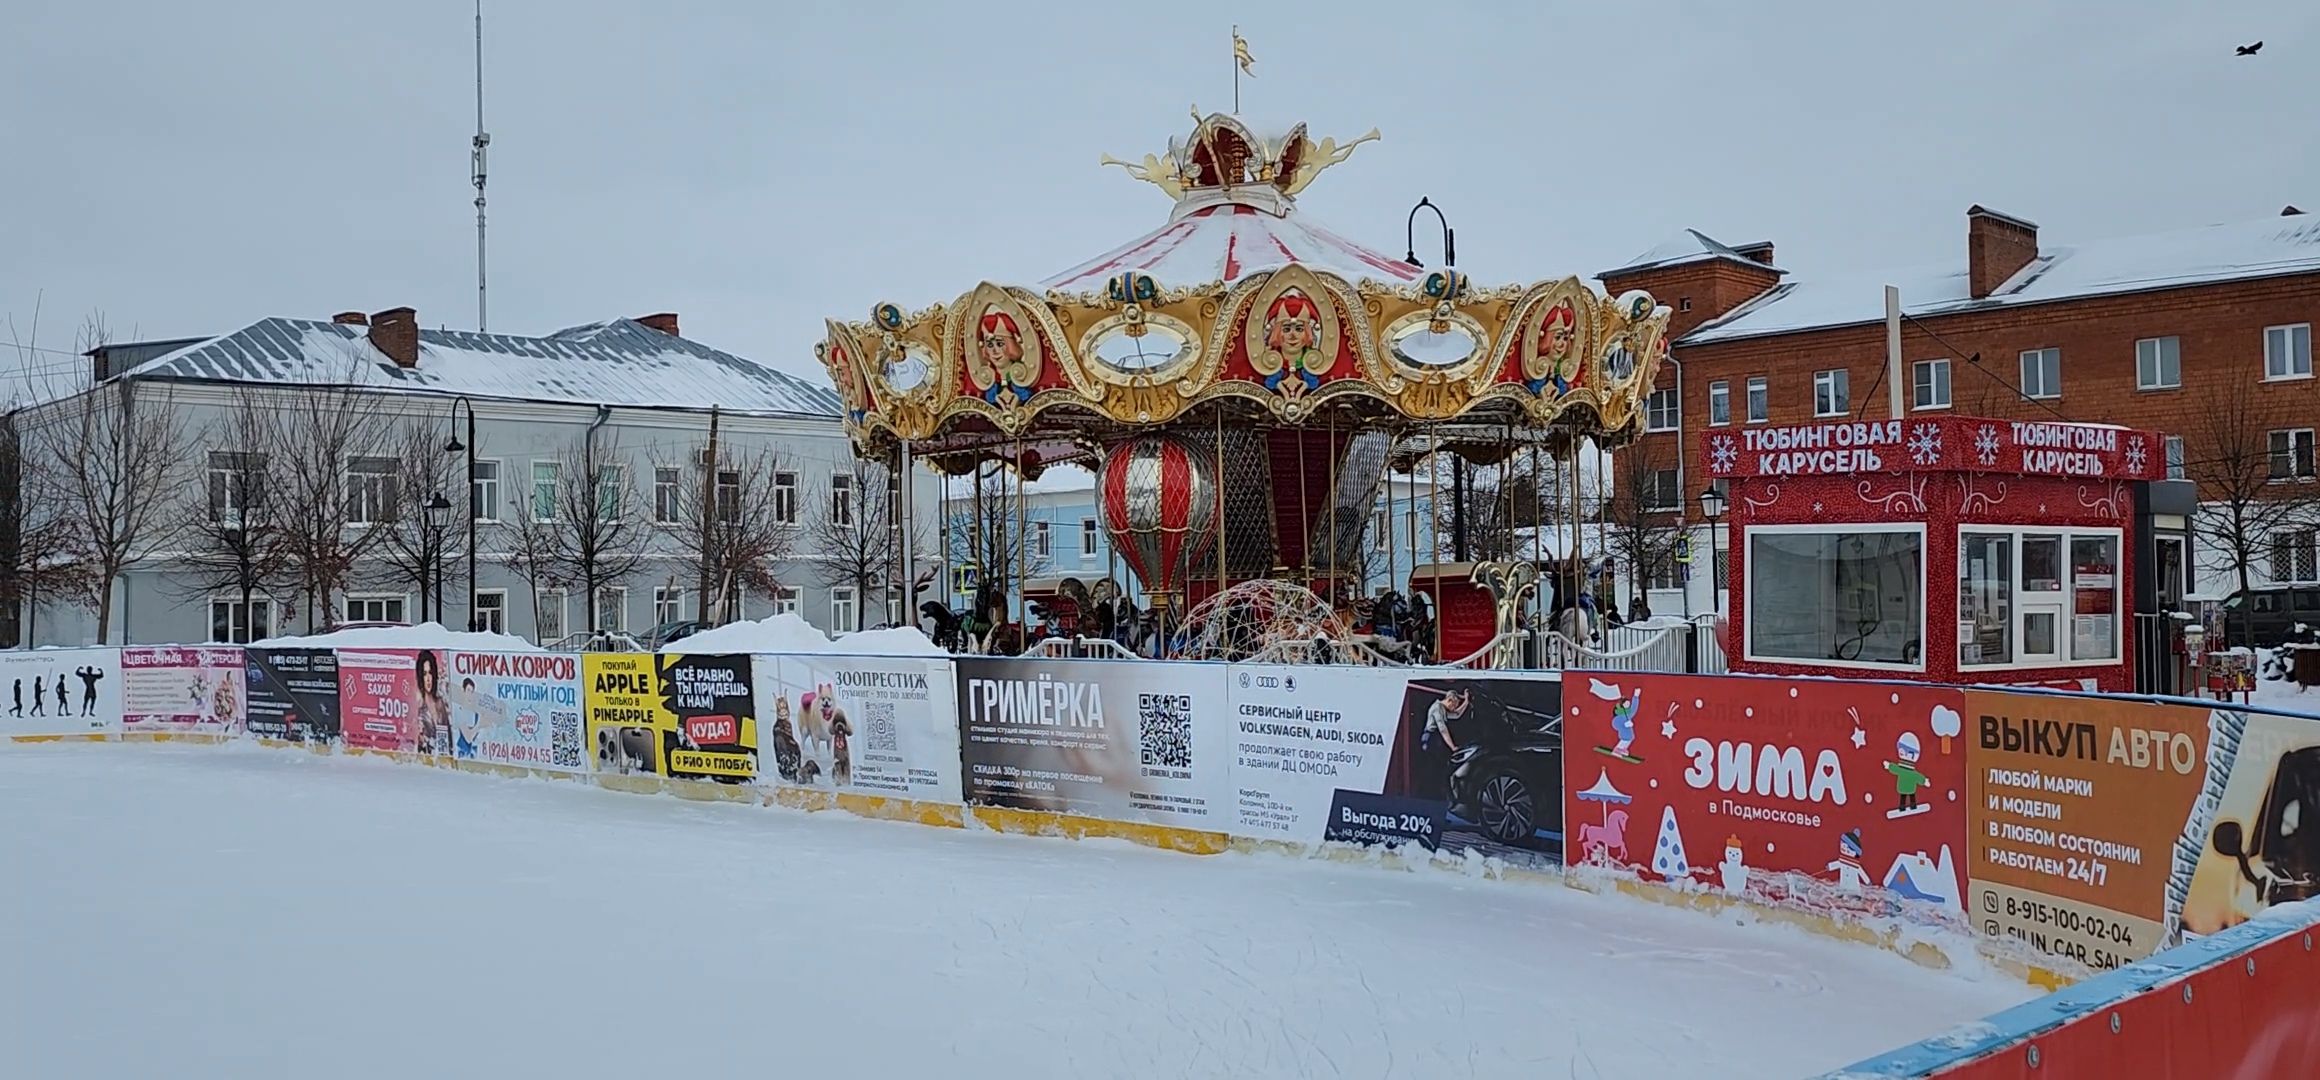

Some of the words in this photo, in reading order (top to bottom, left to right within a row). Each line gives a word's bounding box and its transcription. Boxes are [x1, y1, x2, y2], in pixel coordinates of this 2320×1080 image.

[1742, 420, 1902, 451] ТЮБИНГОВАЯ
[2011, 422, 2117, 452] ТЮБИНГОВАЯ
[1759, 447, 1882, 476] КАРУСЕЛЬ
[2022, 450, 2104, 477] КАРУСЕЛЬ
[126, 653, 182, 666] ЦВЕТОЧНАЯ
[455, 653, 511, 677] СТИРКА
[512, 655, 576, 680] КОВРОВ
[602, 660, 637, 670] ПОКУПАЙ
[595, 673, 649, 695] APPLE
[675, 666, 694, 682] ВСЁ
[697, 668, 735, 682] РАВНО
[834, 671, 929, 690] ЗООПРЕСТИЖ
[497, 683, 548, 701] КРУГЛЫЙ
[551, 686, 576, 707] ГОД
[605, 696, 633, 706] ТОЛЬКО
[635, 698, 640, 706] В
[676, 682, 692, 695] ТЫ
[694, 682, 749, 698] ПРИДЕШЬ
[837, 688, 869, 701] Груминг
[876, 690, 888, 699] это
[889, 691, 899, 700] по
[900, 690, 929, 701] любви!
[968, 673, 1105, 729] ГРИМЁРКА
[677, 695, 685, 707] К
[687, 695, 714, 711] НАМ)
[1239, 703, 1303, 722] СЕРВИСНЫЙ
[1305, 709, 1342, 725] ЦЕНТР
[594, 708, 654, 724] PINEAPPLE
[691, 721, 732, 740] КУДА?
[997, 727, 1017, 736] студия
[1019, 728, 1050, 737] маникюра
[1239, 721, 1314, 741] VOLKSWAGEN,
[1315, 728, 1345, 743] AUDI,
[1347, 731, 1385, 746] SKODA
[482, 742, 487, 755] 8
[489, 743, 509, 763] (926)
[510, 745, 526, 761] 489
[528, 747, 538, 762] 94
[540, 748, 551, 763] 55
[1051, 740, 1078, 750] комфорт
[1239, 743, 1297, 760] продолжает
[1299, 748, 1325, 761] свою
[1326, 750, 1363, 768] работу
[1979, 715, 2098, 761] ВЫКУП
[2106, 725, 2197, 775] АВТО
[683, 757, 703, 768] РИО
[714, 758, 753, 771] ГЛОБУС
[973, 764, 1003, 776] СКИДКА
[1003, 766, 1021, 777] 300р
[1022, 769, 1031, 778] на
[1032, 770, 1060, 781] первое
[1060, 772, 1104, 784] посещение
[1246, 757, 1280, 770] здании
[1281, 758, 1297, 775] ДЦ
[1299, 760, 1338, 777] OMODA
[1683, 736, 1847, 806] ЗИМА
[984, 779, 1024, 791] промокоду
[1988, 768, 2041, 790] ЛЮБОЙ
[2044, 774, 2093, 797] МАРКИ
[1239, 798, 1266, 809] Коломна,
[1709, 803, 1718, 814] в
[1722, 799, 1822, 828] Подмосковье
[1988, 795, 1999, 810] И
[2002, 797, 2062, 820] МОДЕЛИ
[1342, 806, 1397, 830] Выгода
[1400, 814, 1433, 834] 20%
[1342, 828, 1353, 837] на
[1354, 828, 1411, 845] обслуживан
[1988, 821, 1998, 838] В
[2001, 823, 2055, 848] ЛЮБОМ
[2058, 832, 2141, 865] СОСТОЯНИИ
[1989, 847, 2065, 877] РАБОТАЕМ
[2066, 857, 2108, 887] 24/7
[2006, 897, 2133, 947] 8-915-100-02-04
